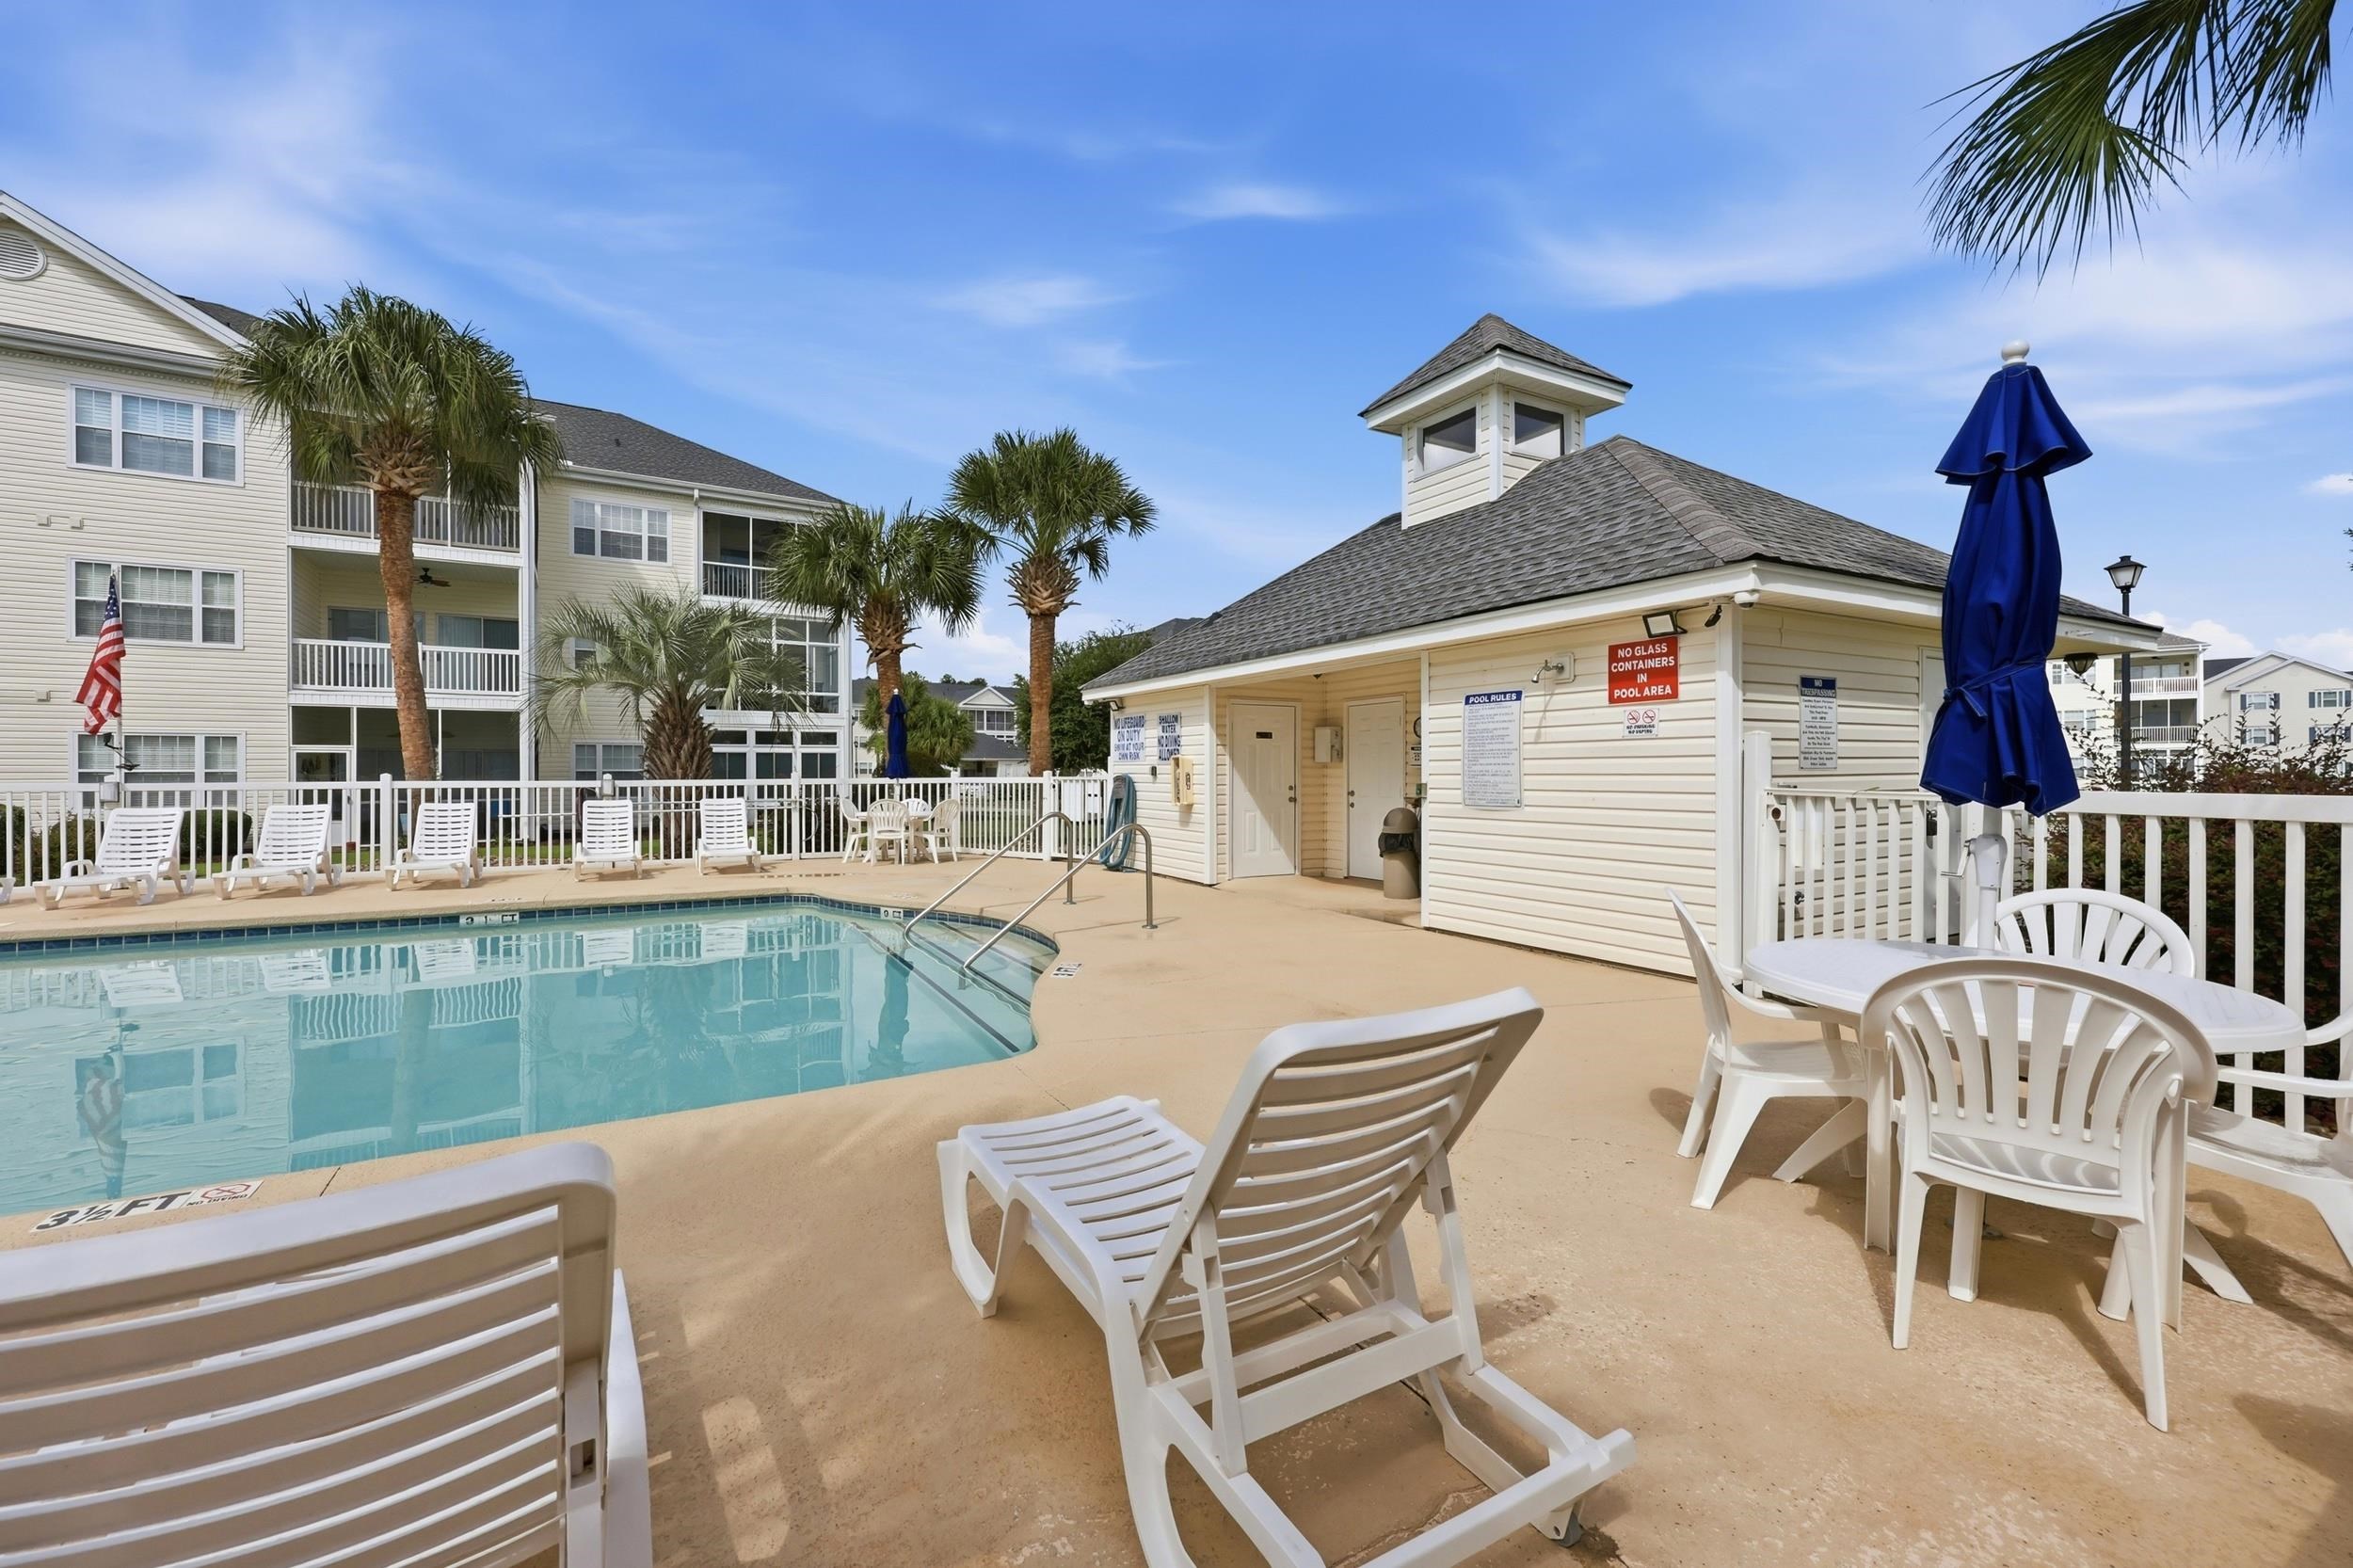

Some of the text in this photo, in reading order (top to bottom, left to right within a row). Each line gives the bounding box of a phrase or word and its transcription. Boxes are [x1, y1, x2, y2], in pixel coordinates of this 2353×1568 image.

[1618, 643, 1668, 658] NO GLASS
[1611, 656, 1674, 672] CONTAINERS
[1637, 673, 1648, 683] IN
[1815, 680, 1823, 688] NO
[1614, 684, 1673, 699] POOL AREA
[1468, 693, 1517, 704] POOL RULES
[1120, 715, 1144, 728] LIFEGUARD
[1159, 714, 1178, 725] SHALLOW
[1161, 724, 1176, 733] WATER
[1117, 729, 1141, 742] ON DUTY
[1158, 734, 1180, 747] NO DIVING
[1114, 742, 1144, 752] SWIM AT YOUR
[1118, 751, 1140, 760] OWN RISK
[115, 1192, 193, 1217] FT
